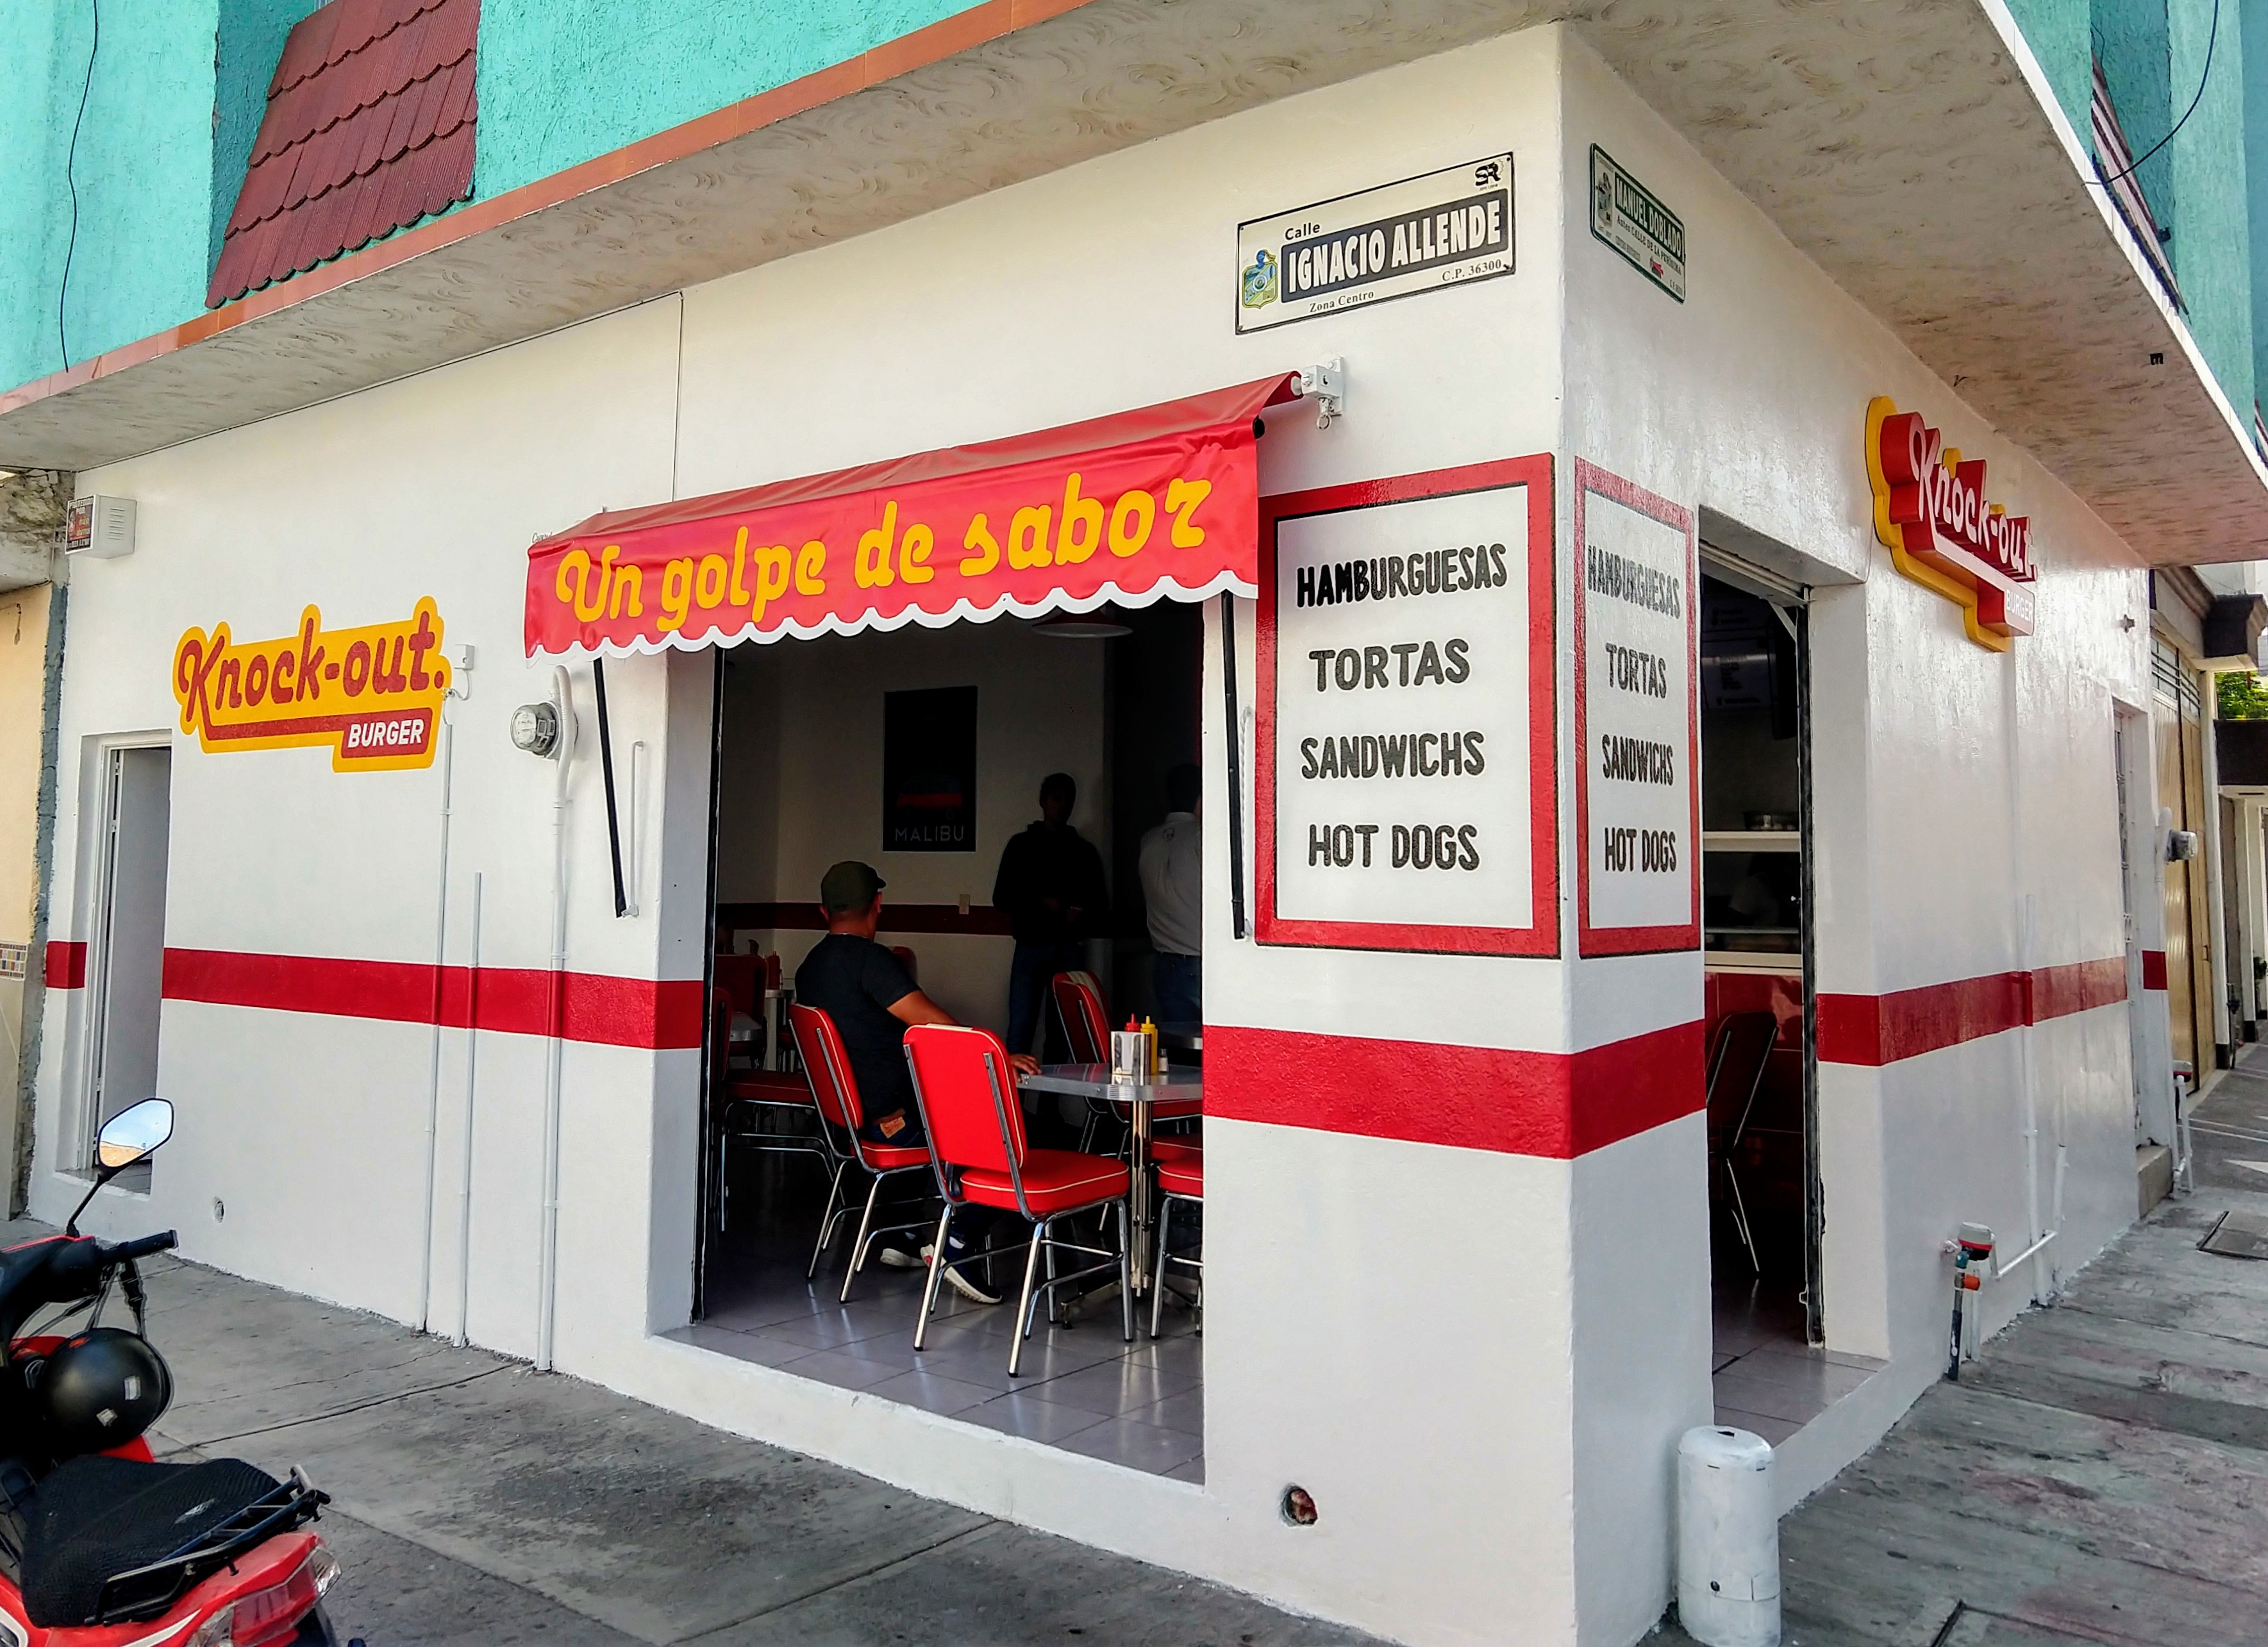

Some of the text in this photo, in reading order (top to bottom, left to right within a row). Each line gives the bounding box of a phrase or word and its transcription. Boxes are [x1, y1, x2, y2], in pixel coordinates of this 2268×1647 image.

[1285, 222, 1321, 240] Calle
[1615, 176, 1648, 231] MANUEL
[1648, 206, 1682, 258] DOBLADO
[1631, 226, 1646, 246] CALLE
[1647, 240, 1654, 252] DE
[1288, 199, 1501, 294] IGNACIO ALLENDE
[1442, 259, 1501, 281] C.P. 36300
[1310, 291, 1374, 313] Zona Centro
[555, 472, 1213, 631] Un golpe de sabor
[1297, 543, 1508, 608] HAMBURGUESAS
[1588, 544, 1681, 620] HAMBURGUESAS
[2006, 589, 2034, 624] BURGER
[1308, 638, 1471, 692] TORTAS
[1605, 642, 1667, 699] TORTAS
[347, 717, 425, 749] BURGER
[1300, 730, 1485, 780] SANDWICHS
[1601, 734, 1674, 786] SANDWICHS
[895, 825, 964, 842] MALIBU
[1308, 824, 1480, 871] HOT DOGS
[1605, 828, 1676, 873] HOT DOGS
